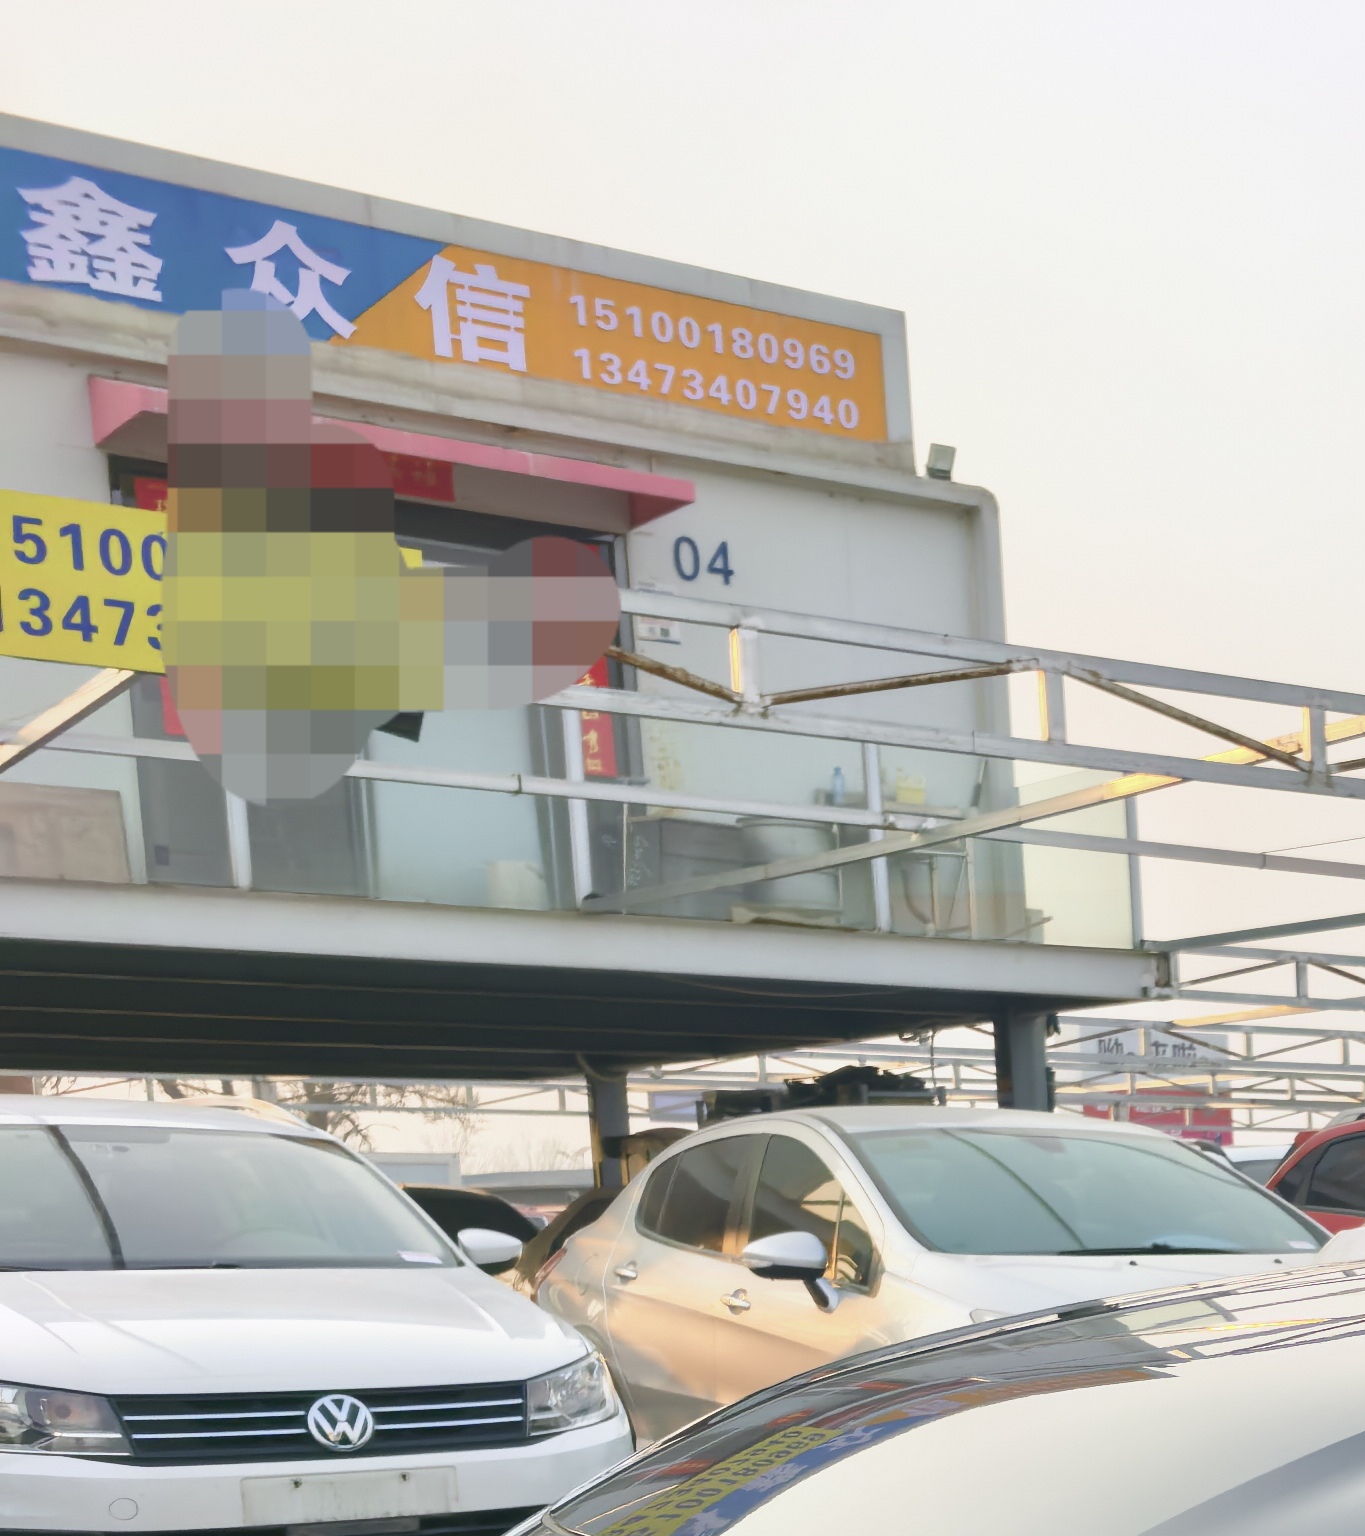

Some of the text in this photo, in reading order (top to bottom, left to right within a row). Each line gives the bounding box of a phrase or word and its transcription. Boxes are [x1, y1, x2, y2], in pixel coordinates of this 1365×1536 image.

[16, 176, 530, 372] 鑫众信
[570, 295, 854, 380] 15100180969
[574, 349, 858, 429] 13473407940
[674, 536, 734, 586] 04
